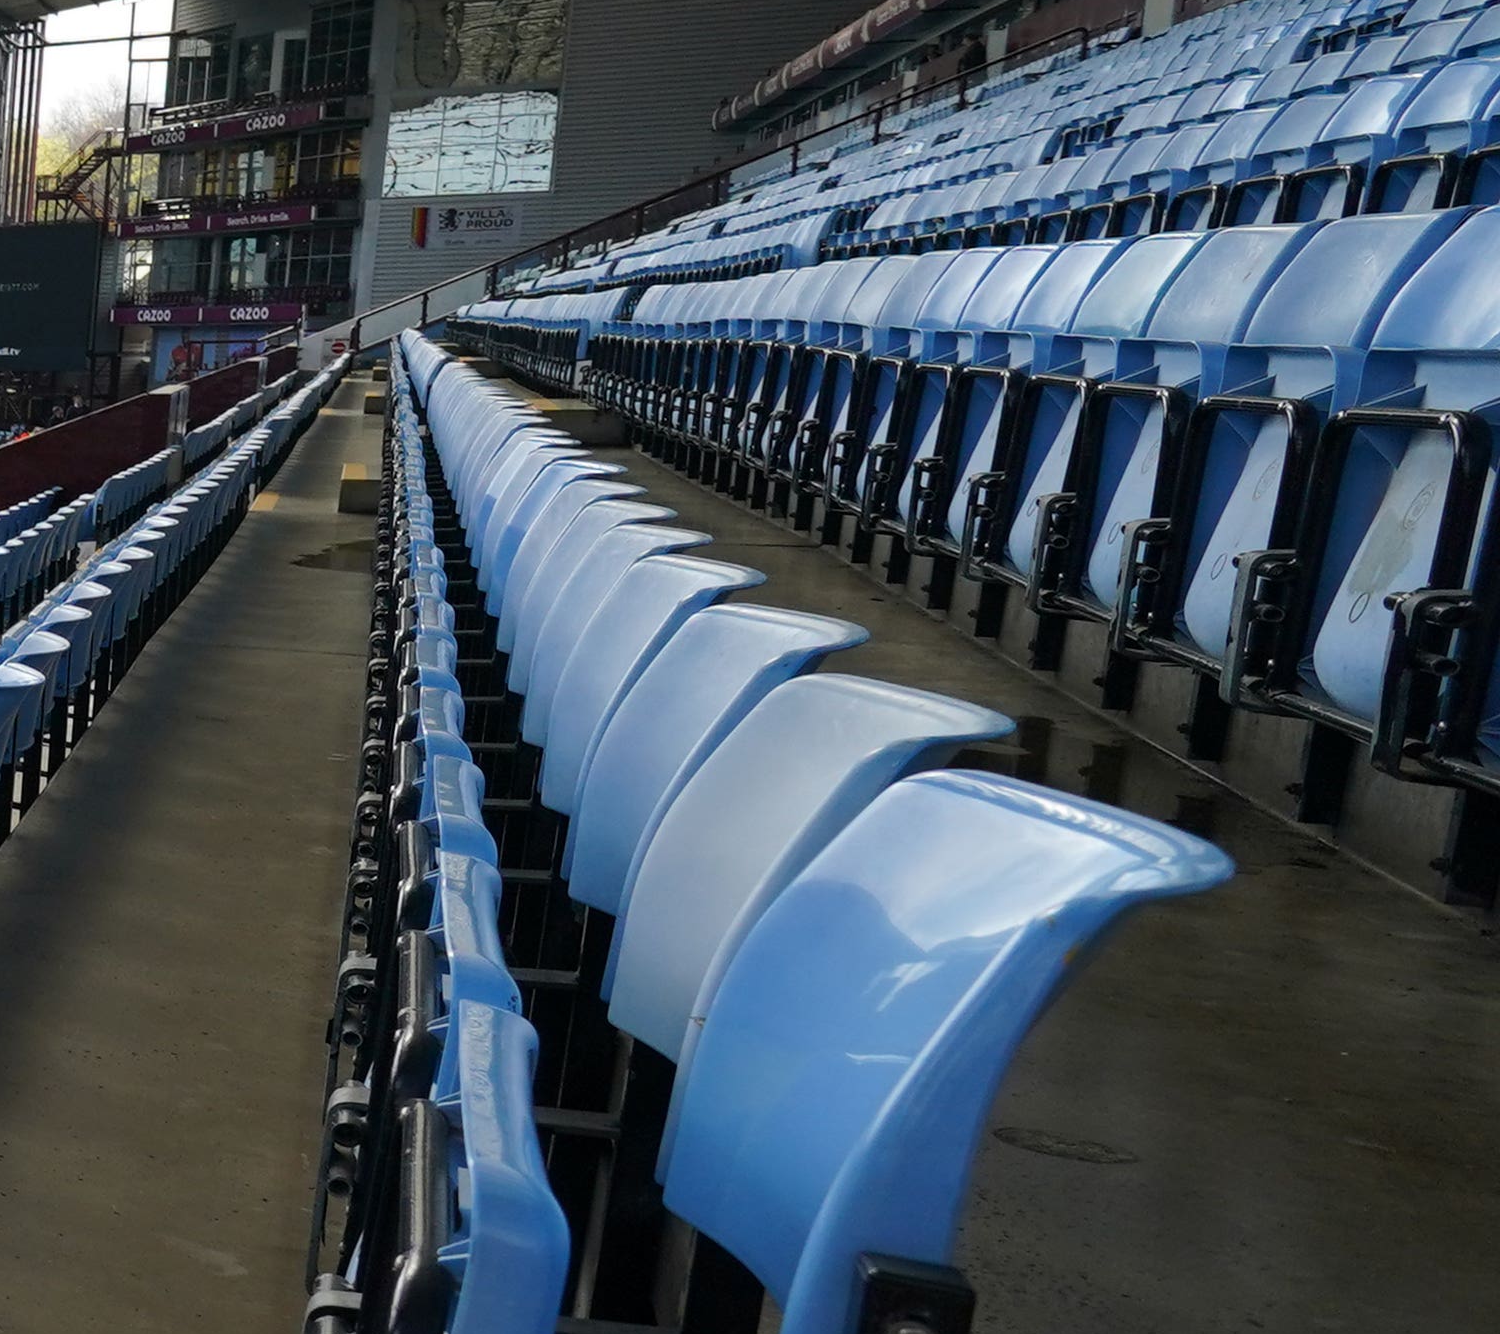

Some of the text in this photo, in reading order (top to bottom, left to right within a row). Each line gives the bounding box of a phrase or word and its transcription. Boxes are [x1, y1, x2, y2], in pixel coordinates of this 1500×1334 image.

[246, 114, 286, 131] CAZOO
[151, 130, 186, 146] CAZOO
[466, 209, 506, 219] VILLA
[465, 218, 514, 228] PROUD
[137, 309, 171, 322] CAZOO
[229, 306, 270, 321] CAZOO
